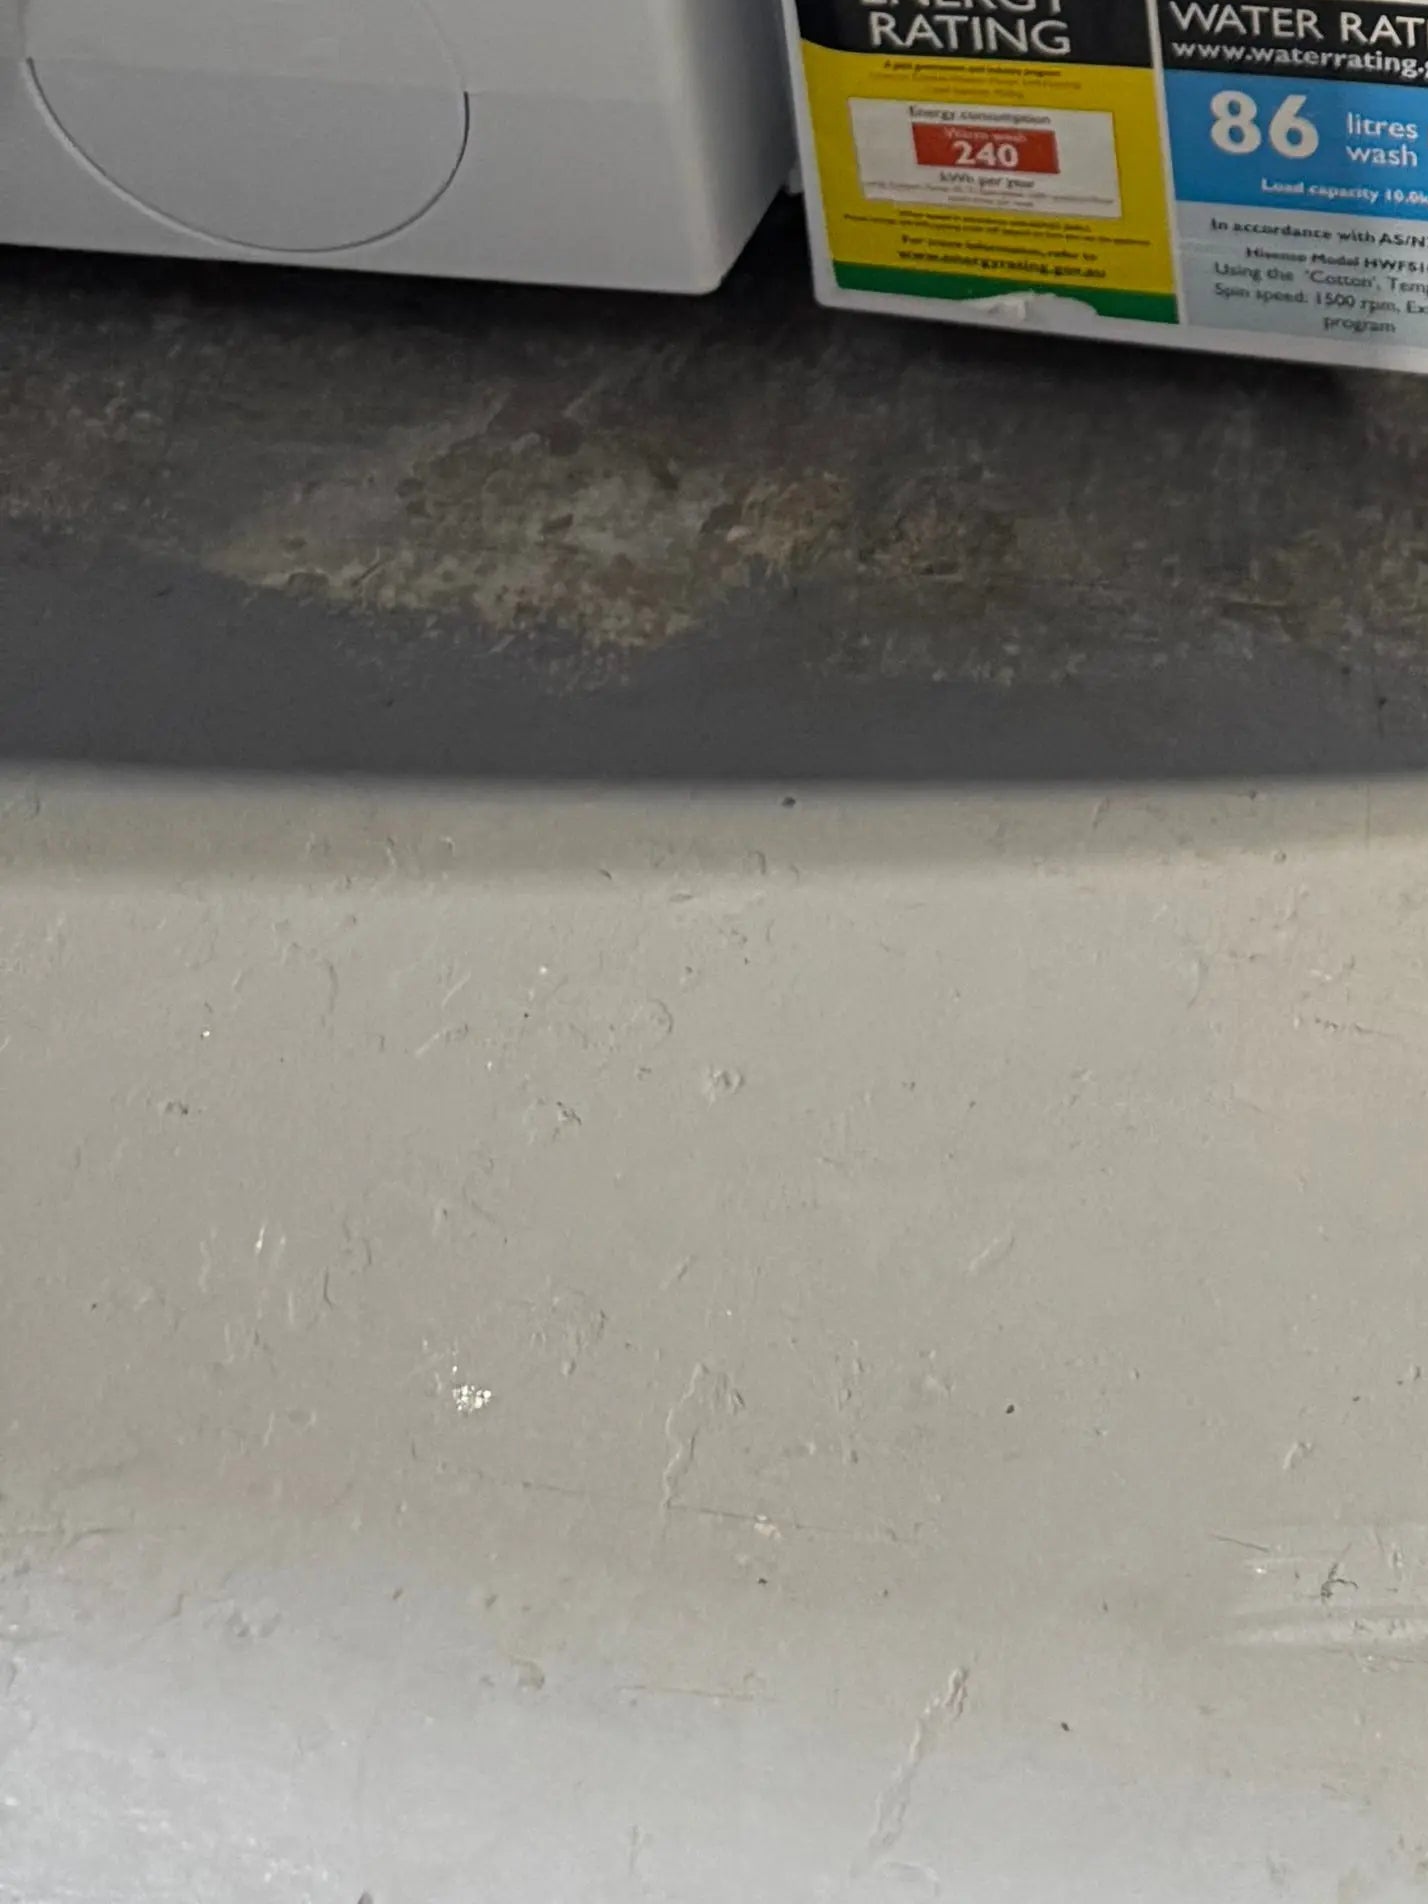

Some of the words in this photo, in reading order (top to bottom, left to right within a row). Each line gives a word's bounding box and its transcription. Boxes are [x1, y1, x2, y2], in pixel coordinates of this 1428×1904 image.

[869, 11, 1071, 55] RATING
[1169, 0, 1324, 40] WATER
[1209, 90, 1319, 159] 86
[1347, 111, 1418, 139] litres
[951, 141, 1018, 168] 240
[1346, 144, 1418, 168] wash
[1261, 177, 1304, 193] Load
[1309, 183, 1378, 203] capacity
[1211, 218, 1228, 231] In
[1232, 222, 1331, 240] accordance
[1337, 229, 1375, 243] with
[1215, 262, 1262, 282] Using
[1267, 267, 1293, 282] the
[1316, 292, 1355, 308] 1500
[1323, 315, 1396, 334] program
